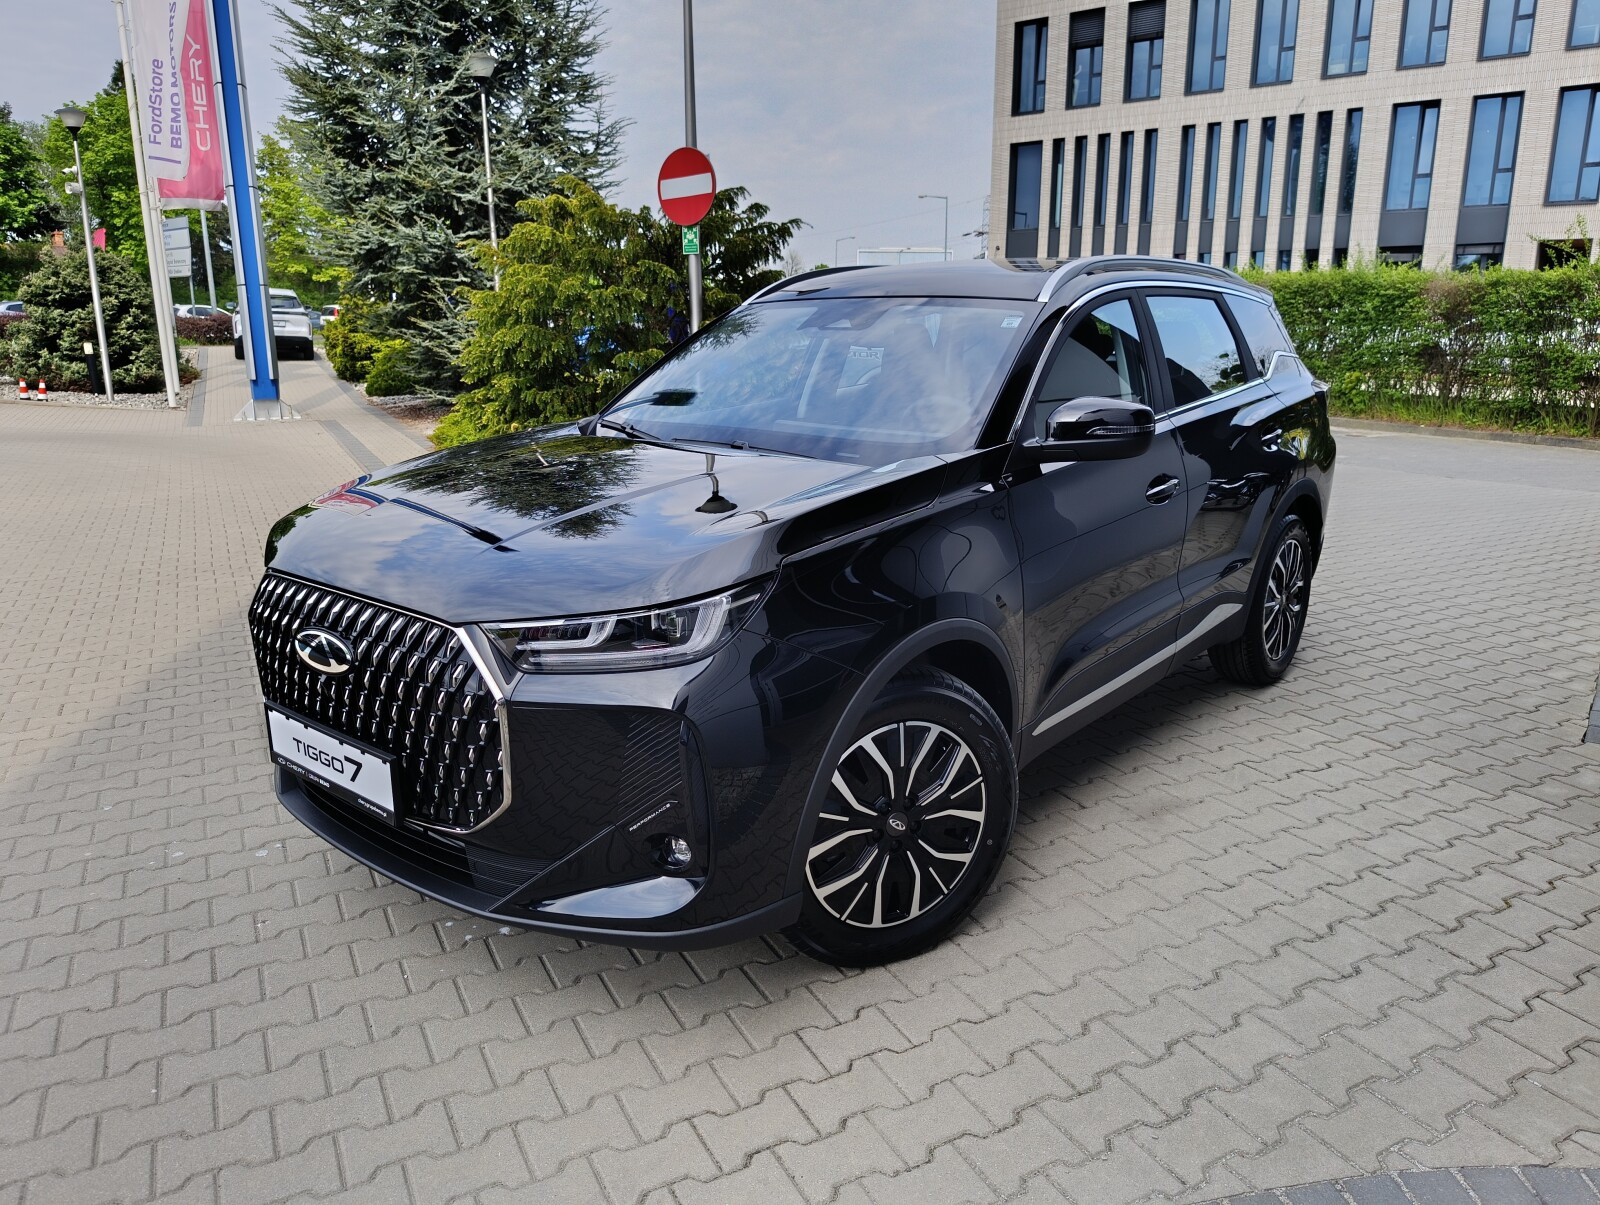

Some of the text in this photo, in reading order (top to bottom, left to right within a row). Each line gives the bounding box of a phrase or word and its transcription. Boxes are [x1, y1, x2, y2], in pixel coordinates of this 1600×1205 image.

[148, 58, 164, 146] FordStore
[168, 1, 182, 150] BEMO MOTORS
[186, 34, 211, 151] CHERY
[629, 803, 671, 832] PERFORMANCE
